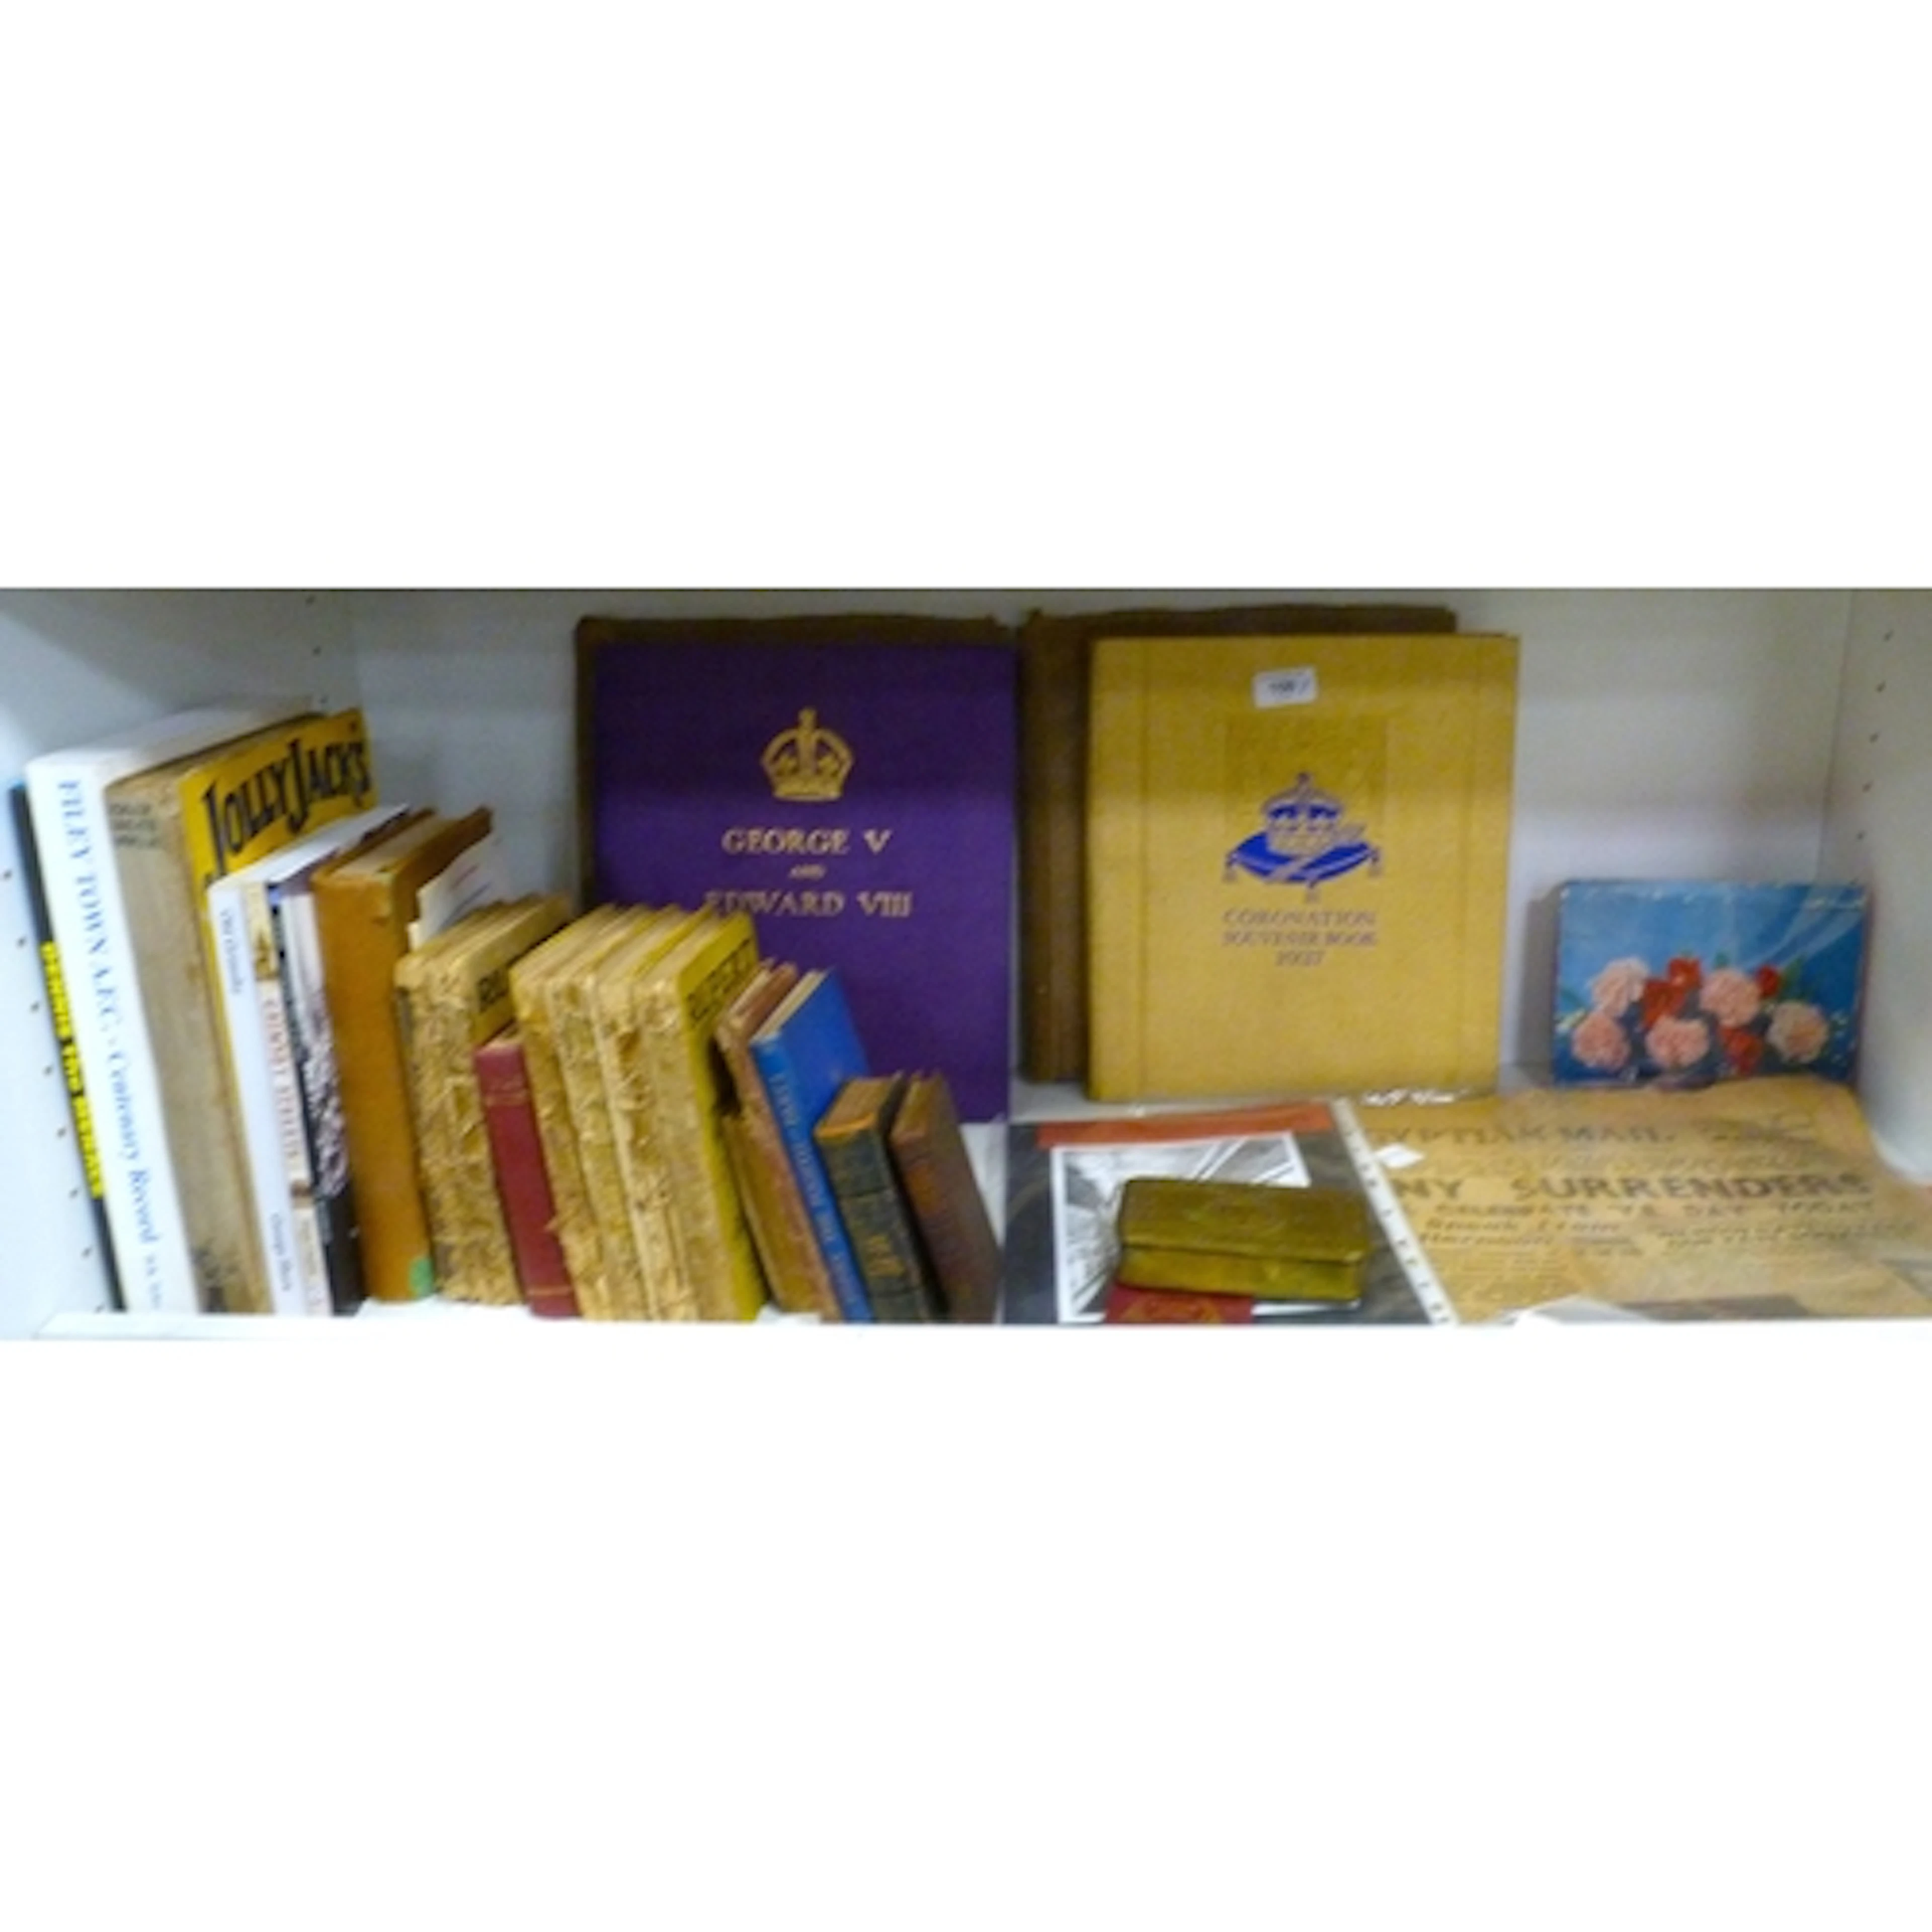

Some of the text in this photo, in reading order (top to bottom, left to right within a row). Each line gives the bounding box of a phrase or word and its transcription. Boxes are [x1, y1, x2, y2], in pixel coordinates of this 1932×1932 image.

[721, 828, 894, 855] GEORGE V
[705, 889, 914, 918] EDWARD VIII
[1223, 908, 1377, 927] CORONATION
[57, 780, 92, 860] FILEY
[75, 874, 108, 955] TOWN
[106, 1050, 142, 1162] Centenary
[128, 1168, 160, 1244] Record
[1510, 1172, 1872, 1199] SURRENDERS
